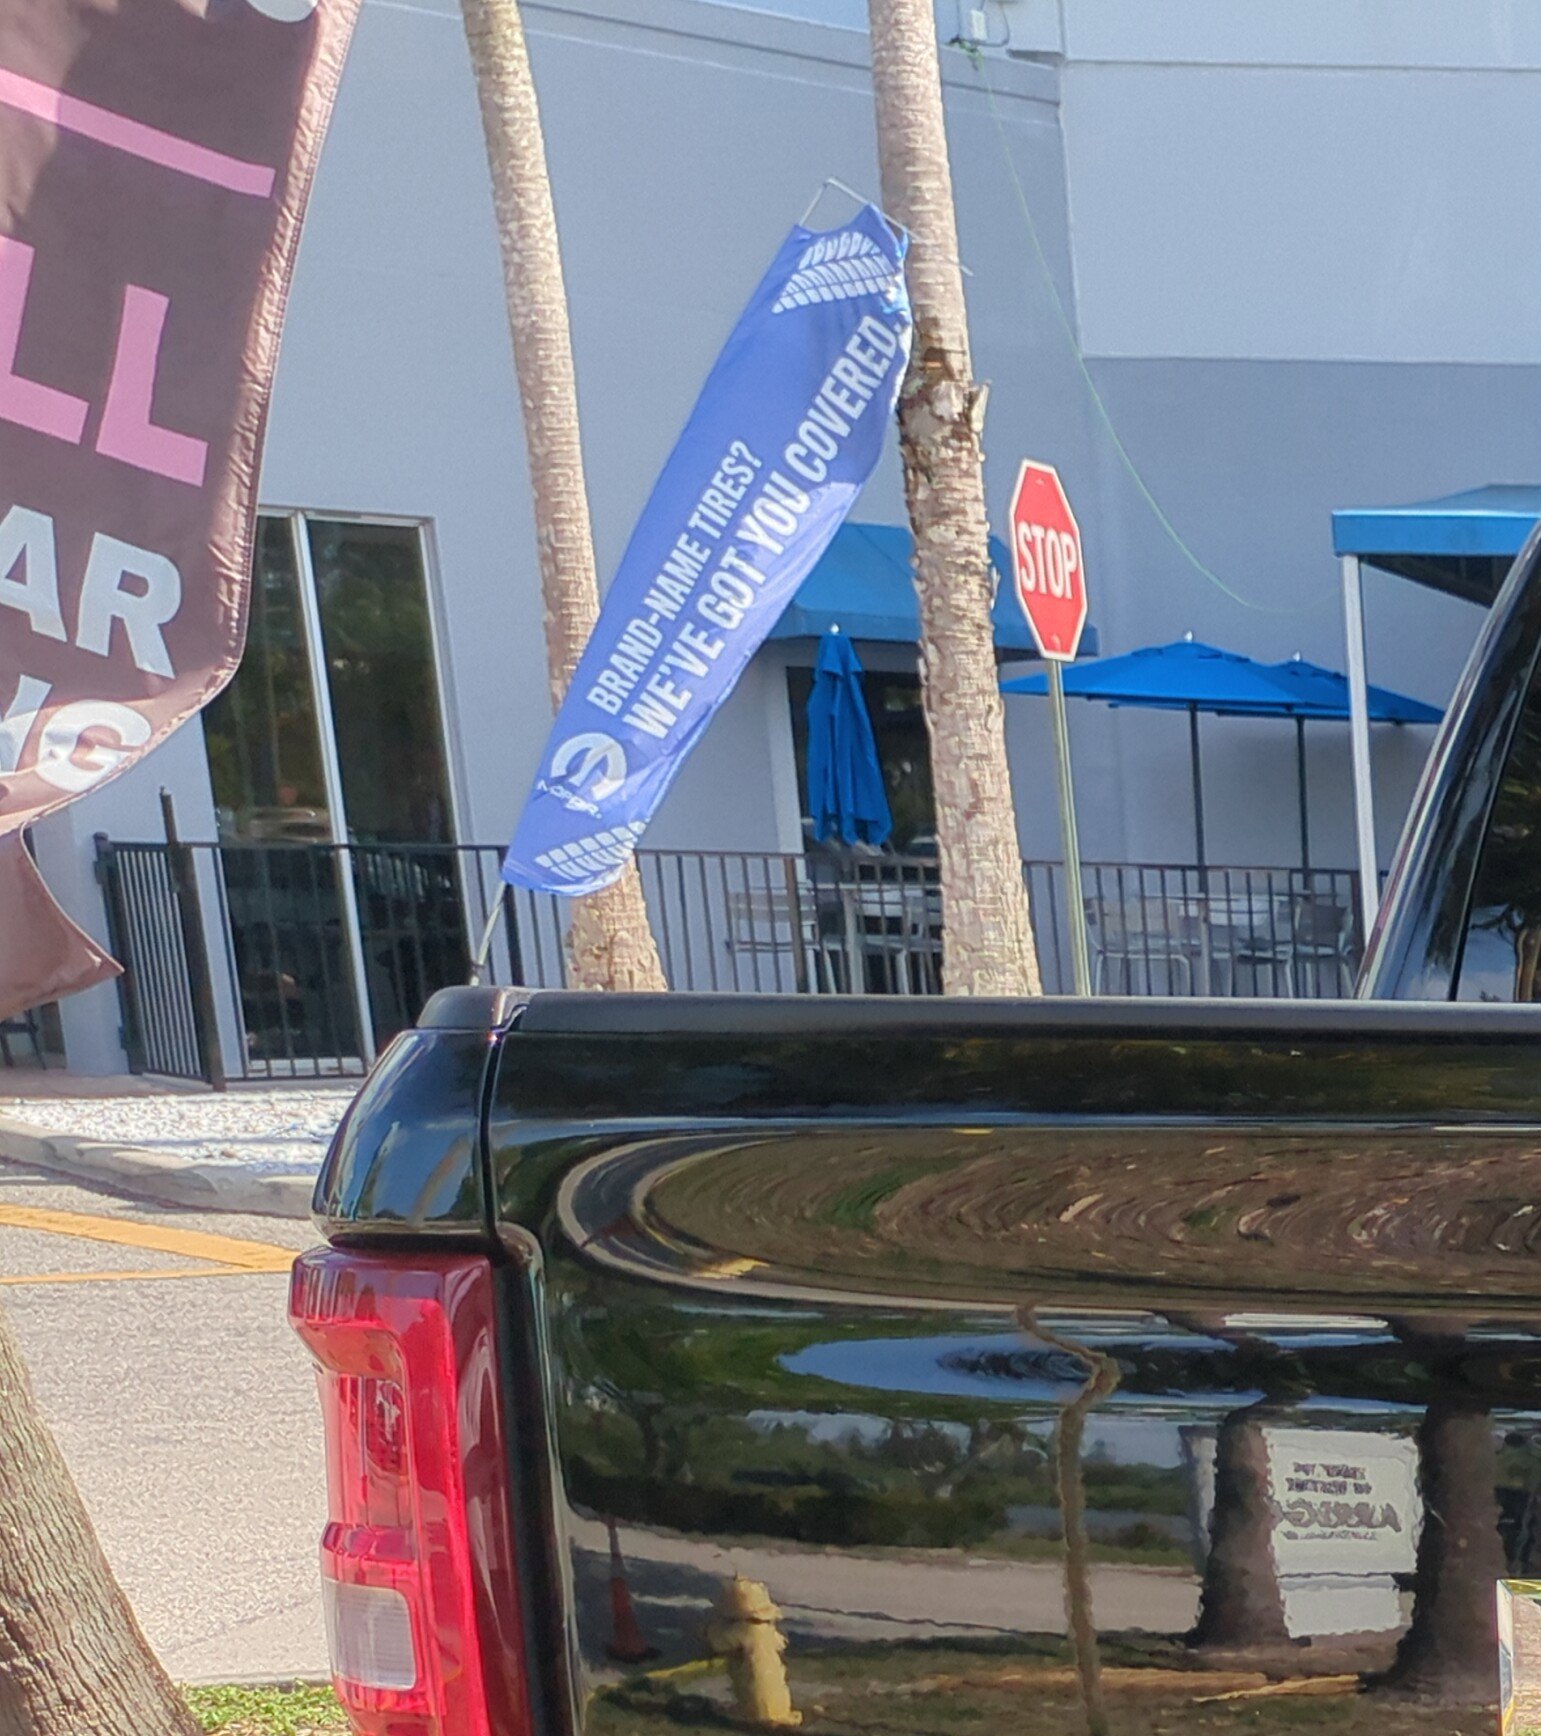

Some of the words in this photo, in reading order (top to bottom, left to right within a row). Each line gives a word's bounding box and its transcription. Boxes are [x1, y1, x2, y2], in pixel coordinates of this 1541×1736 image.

[586, 532, 713, 716] BRAND-NAME
[688, 440, 763, 539] TIRES?
[622, 621, 726, 740] WE'VE
[697, 545, 768, 631] GOT
[735, 470, 812, 556] YOU
[1017, 521, 1078, 600] STOP
